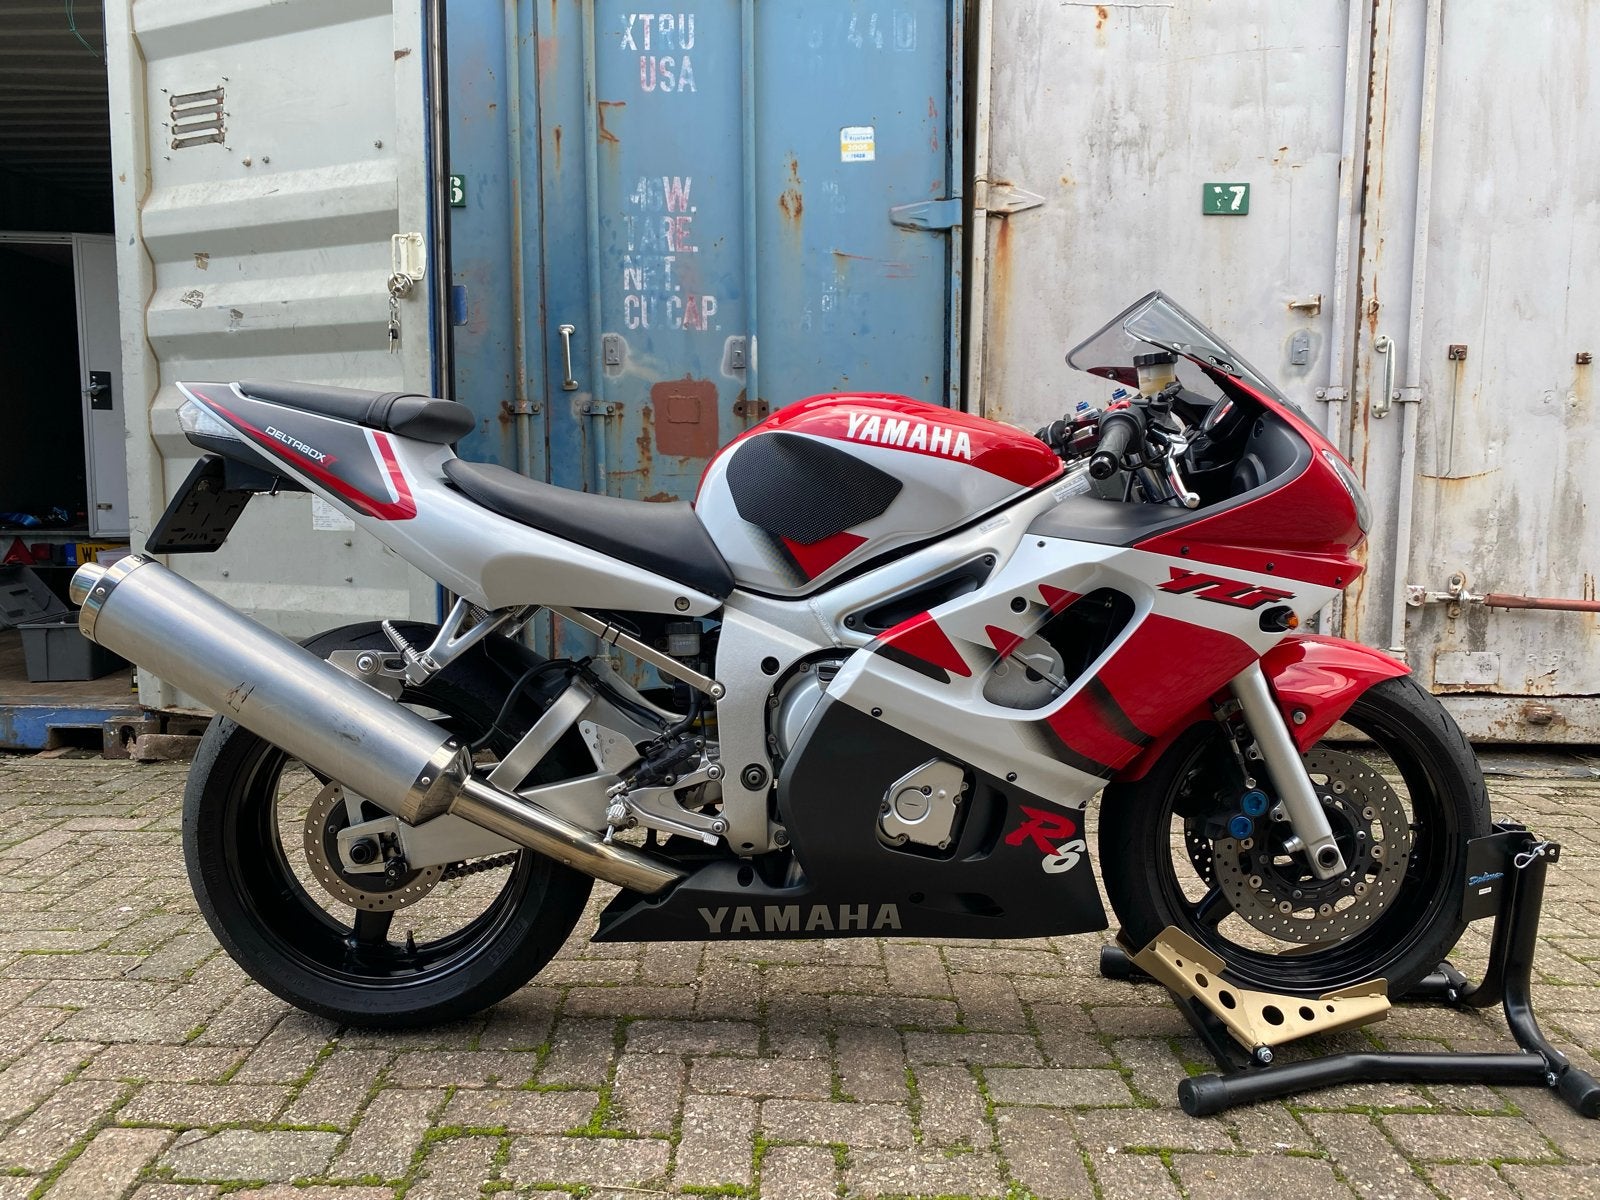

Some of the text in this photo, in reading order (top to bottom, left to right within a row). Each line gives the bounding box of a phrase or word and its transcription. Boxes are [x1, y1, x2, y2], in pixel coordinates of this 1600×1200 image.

[639, 55, 697, 92] USA
[265, 426, 326, 463] DELTABOX
[846, 411, 972, 461] YAMAHA
[1155, 566, 1298, 611] YZF
[1004, 804, 1087, 874] R6
[697, 903, 903, 934] YAMAHA
